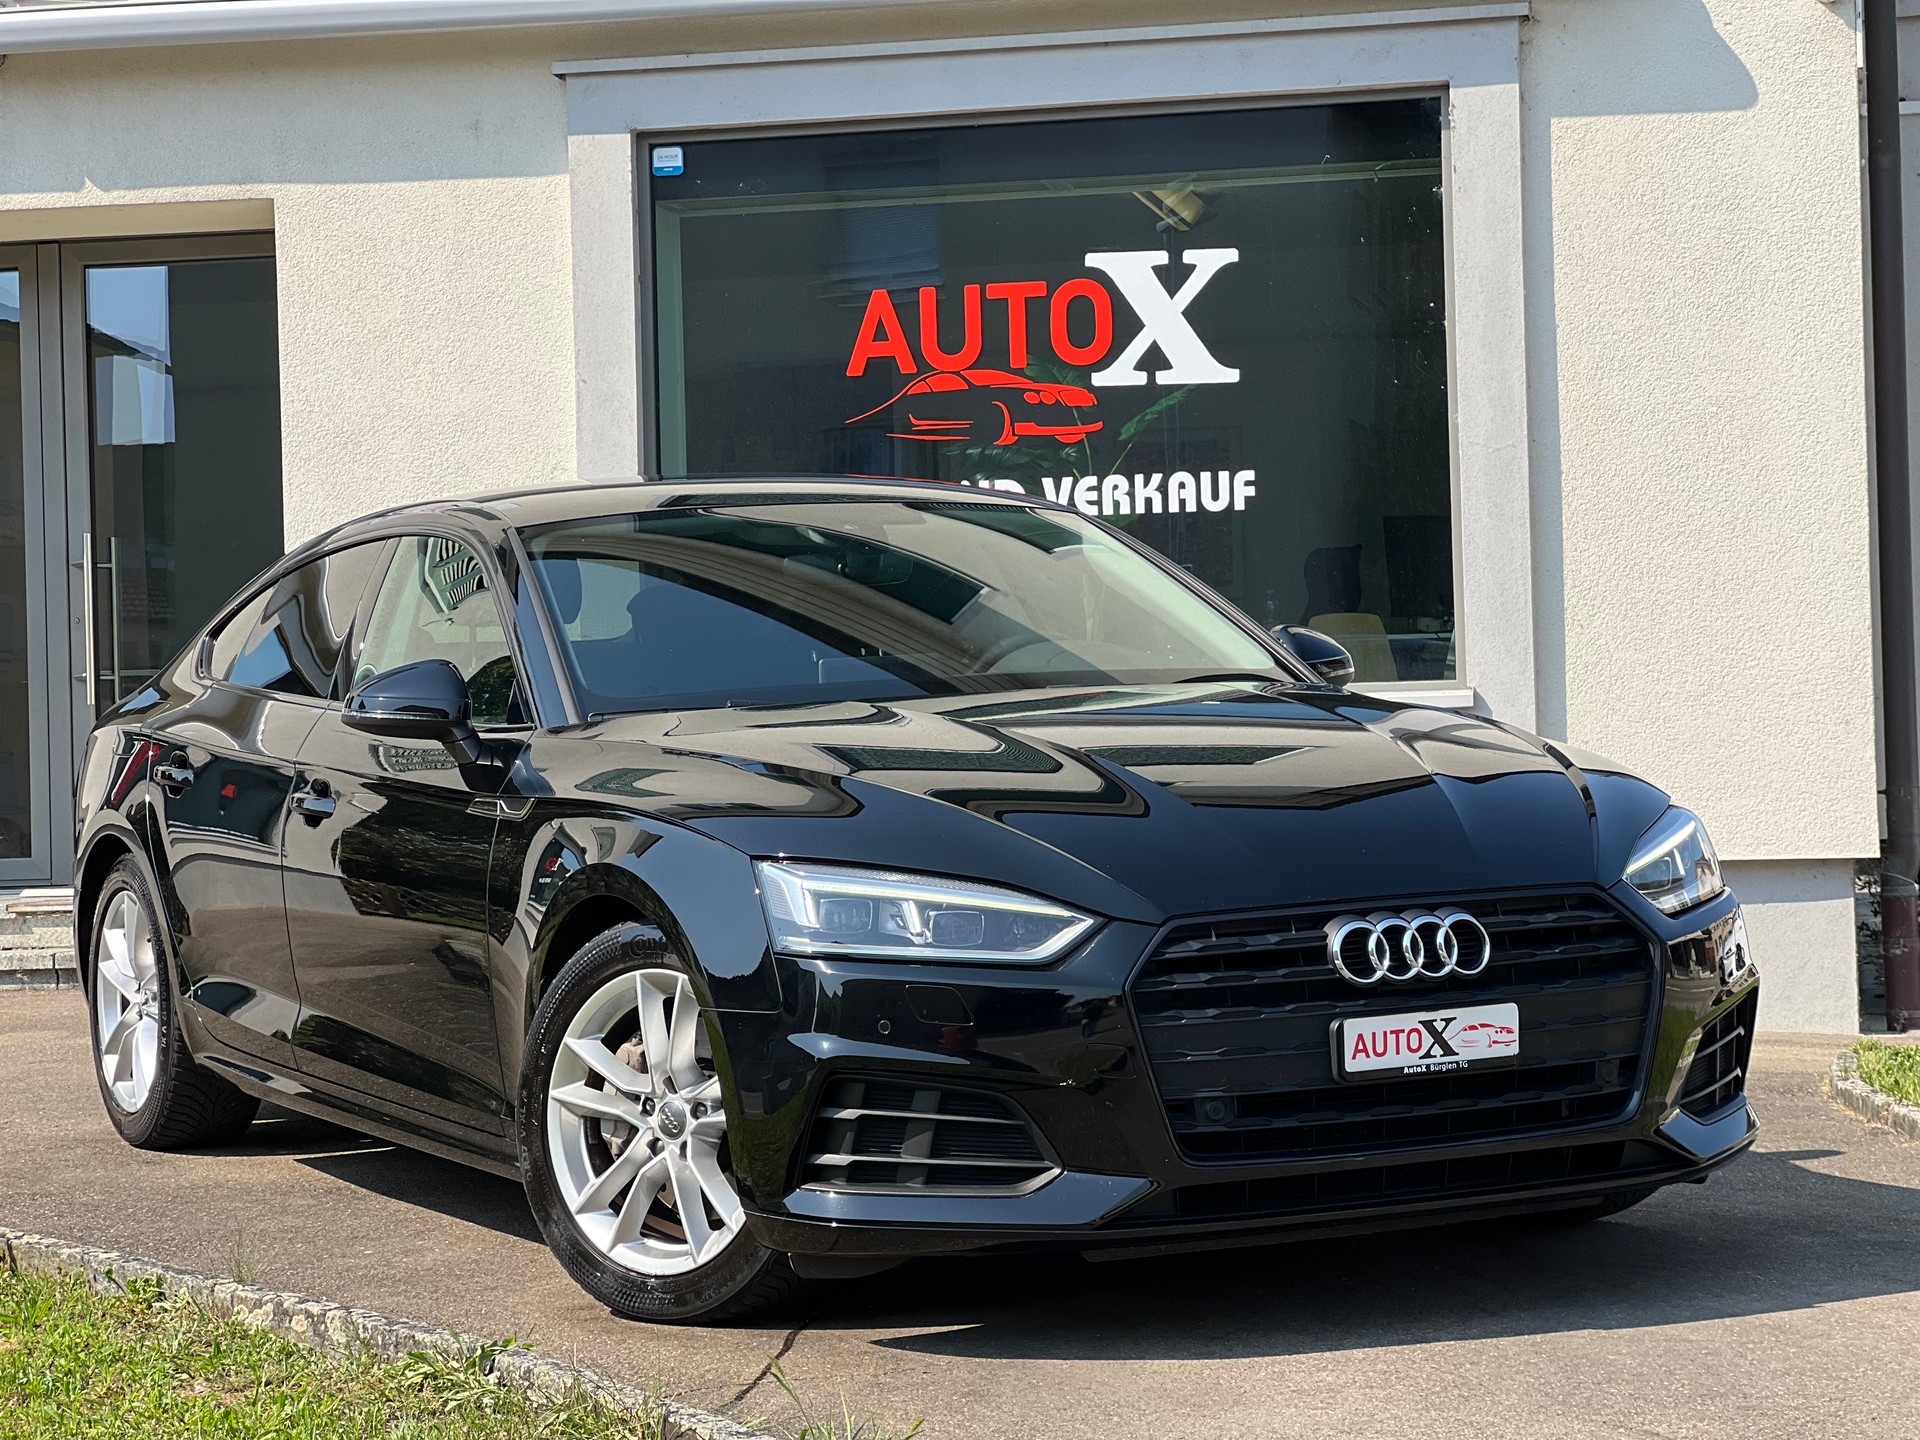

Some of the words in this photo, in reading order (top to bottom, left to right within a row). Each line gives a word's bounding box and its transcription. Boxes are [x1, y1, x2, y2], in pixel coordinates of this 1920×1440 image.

[845, 247, 1240, 387] AUTOX
[1041, 469, 1256, 516] VERKAUF
[1351, 1017, 1459, 1060] AUTOX
[1403, 1065, 1427, 1074] AutoX
[1430, 1062, 1457, 1072] Bürglen
